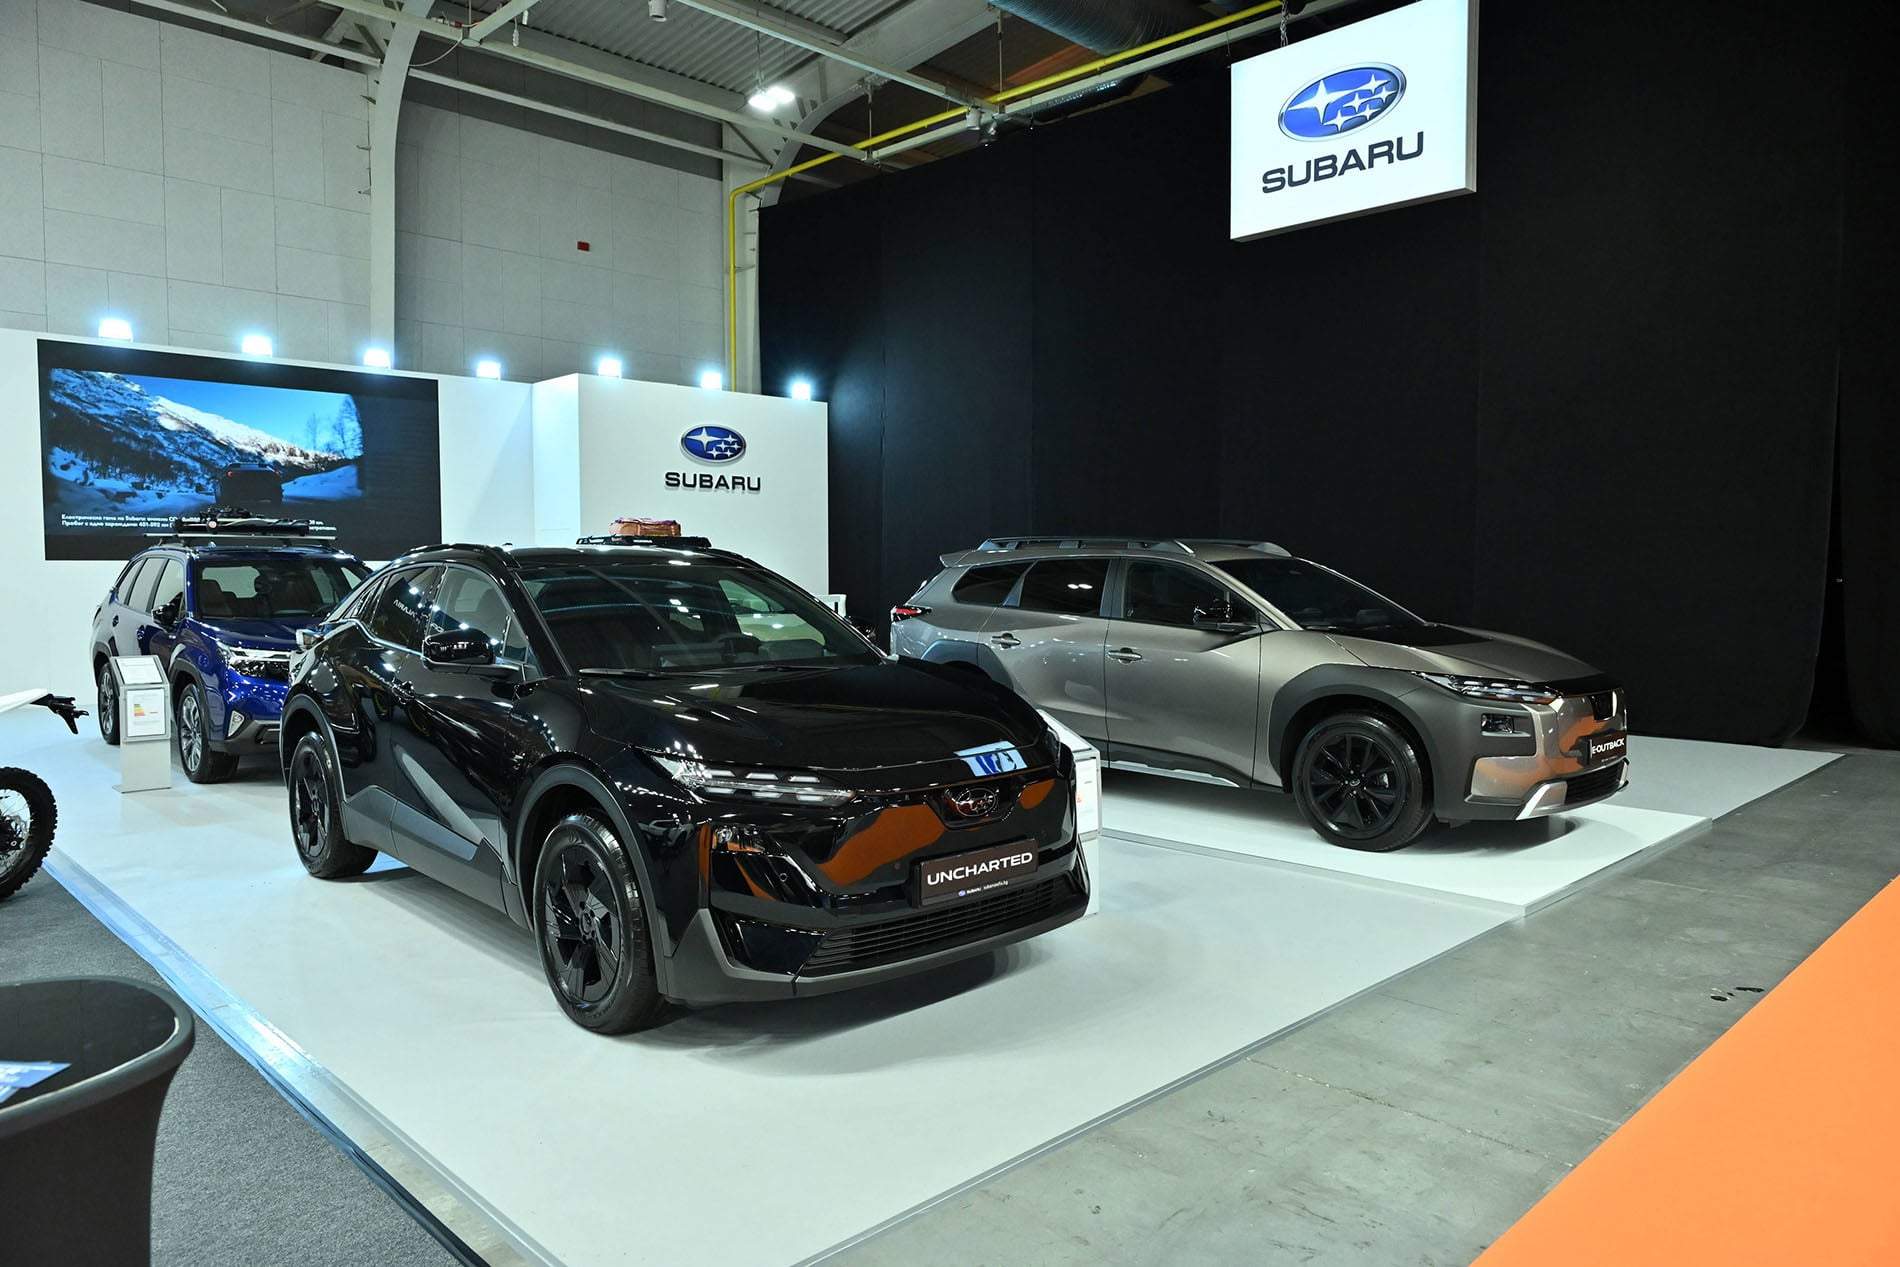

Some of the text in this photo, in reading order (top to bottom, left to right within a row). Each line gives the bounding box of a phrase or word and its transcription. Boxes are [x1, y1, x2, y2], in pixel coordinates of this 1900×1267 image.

[1262, 131, 1424, 194] SUBARU
[665, 471, 761, 492] SUBARU
[927, 852, 1033, 886] UNCHARTED
